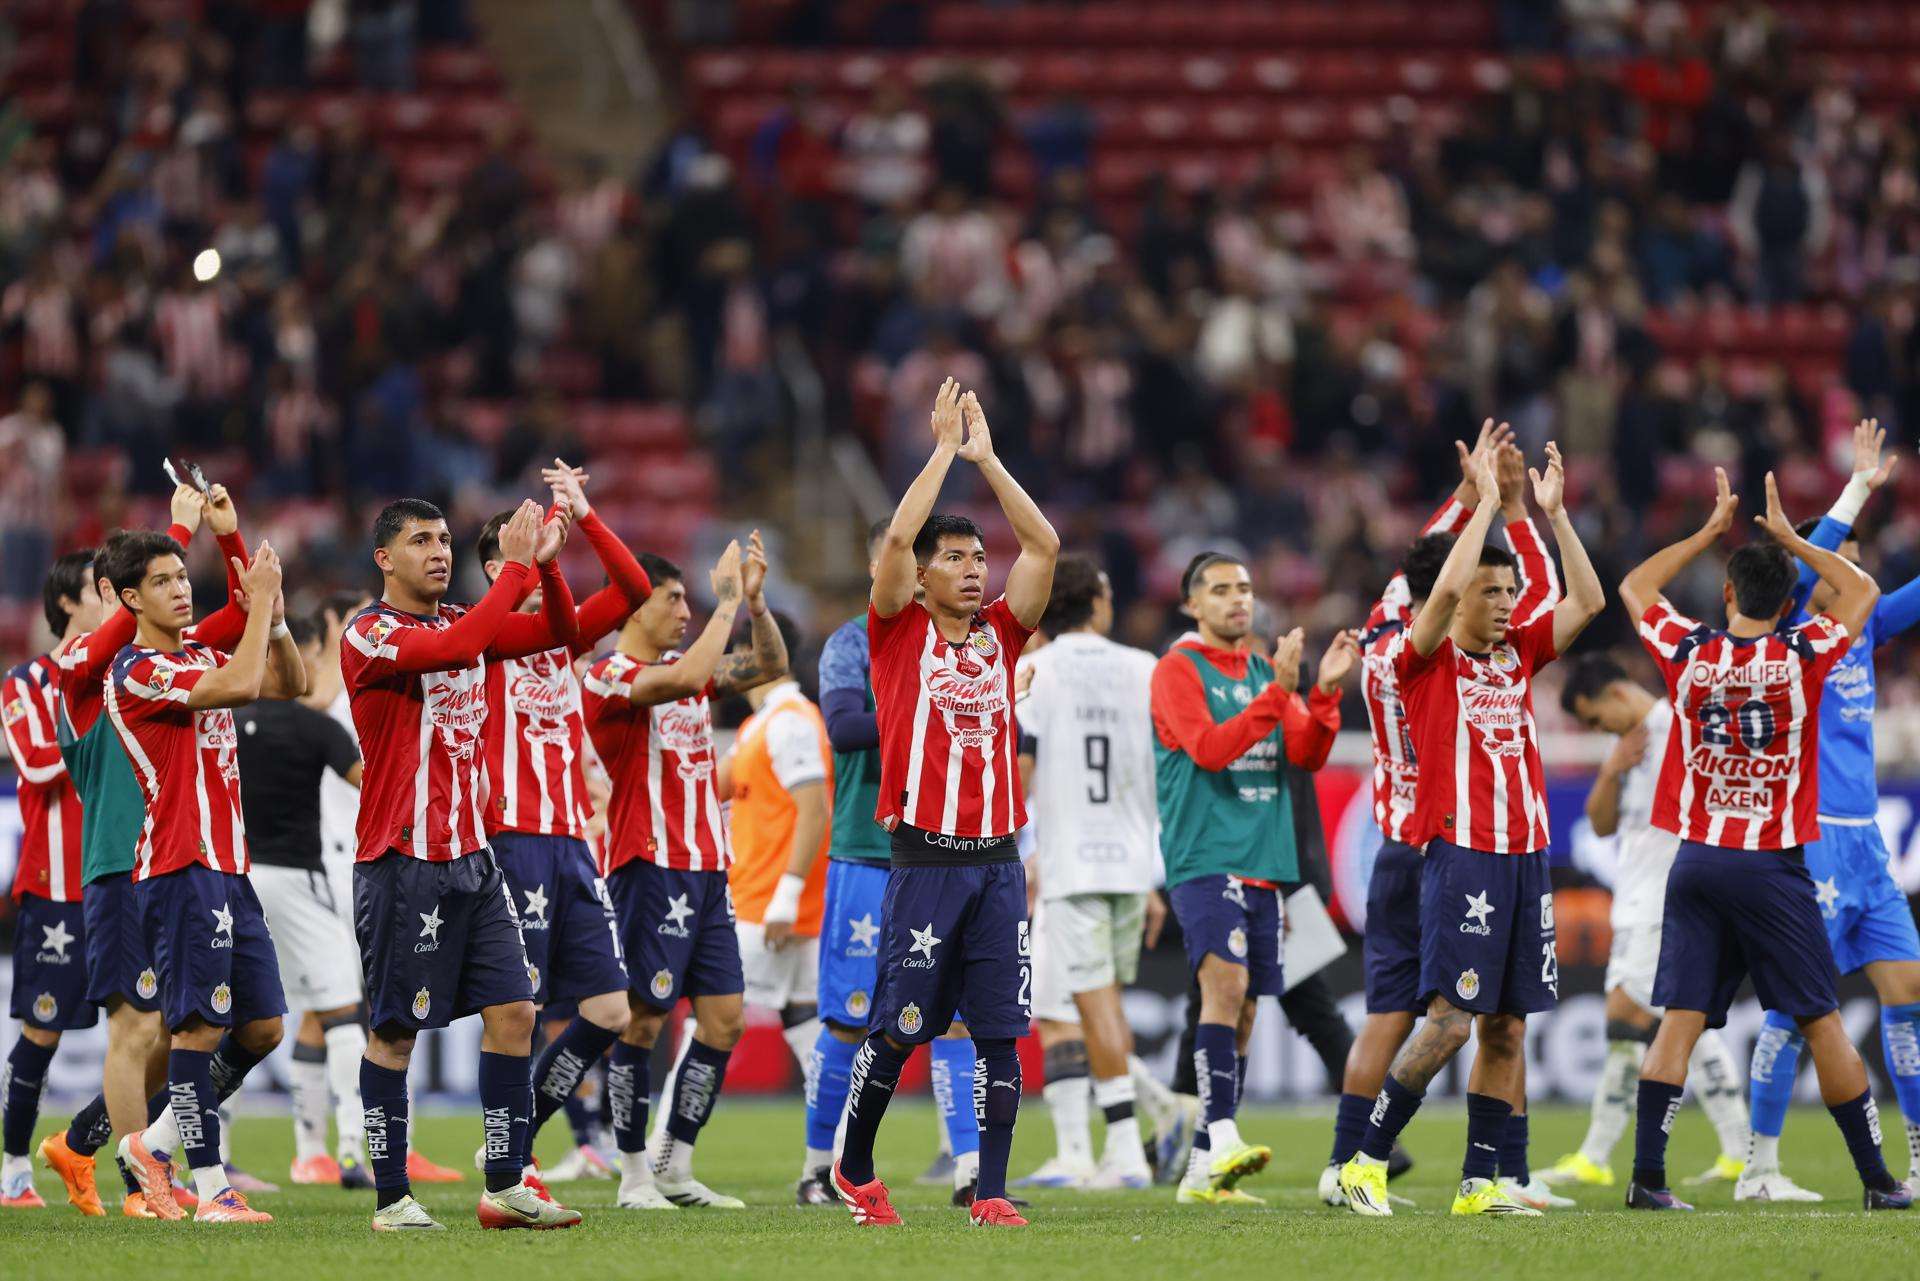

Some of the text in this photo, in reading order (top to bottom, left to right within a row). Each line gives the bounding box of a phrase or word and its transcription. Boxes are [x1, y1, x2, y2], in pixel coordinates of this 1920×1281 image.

[1694, 664, 1786, 684] OMNILIFE
[963, 737, 984, 746] pago
[1698, 699, 1776, 750] 20
[1084, 732, 1111, 804] 9
[1687, 748, 1795, 778] AKRON
[1710, 789, 1769, 808] AXEN
[924, 831, 974, 851] Calvin
[608, 1060, 635, 1132] PERDURA
[848, 1037, 877, 1119] PERDURA
[973, 1057, 989, 1132] PERDURA
[168, 1081, 206, 1150] PERDURA
[484, 1106, 510, 1161] PERDURA
